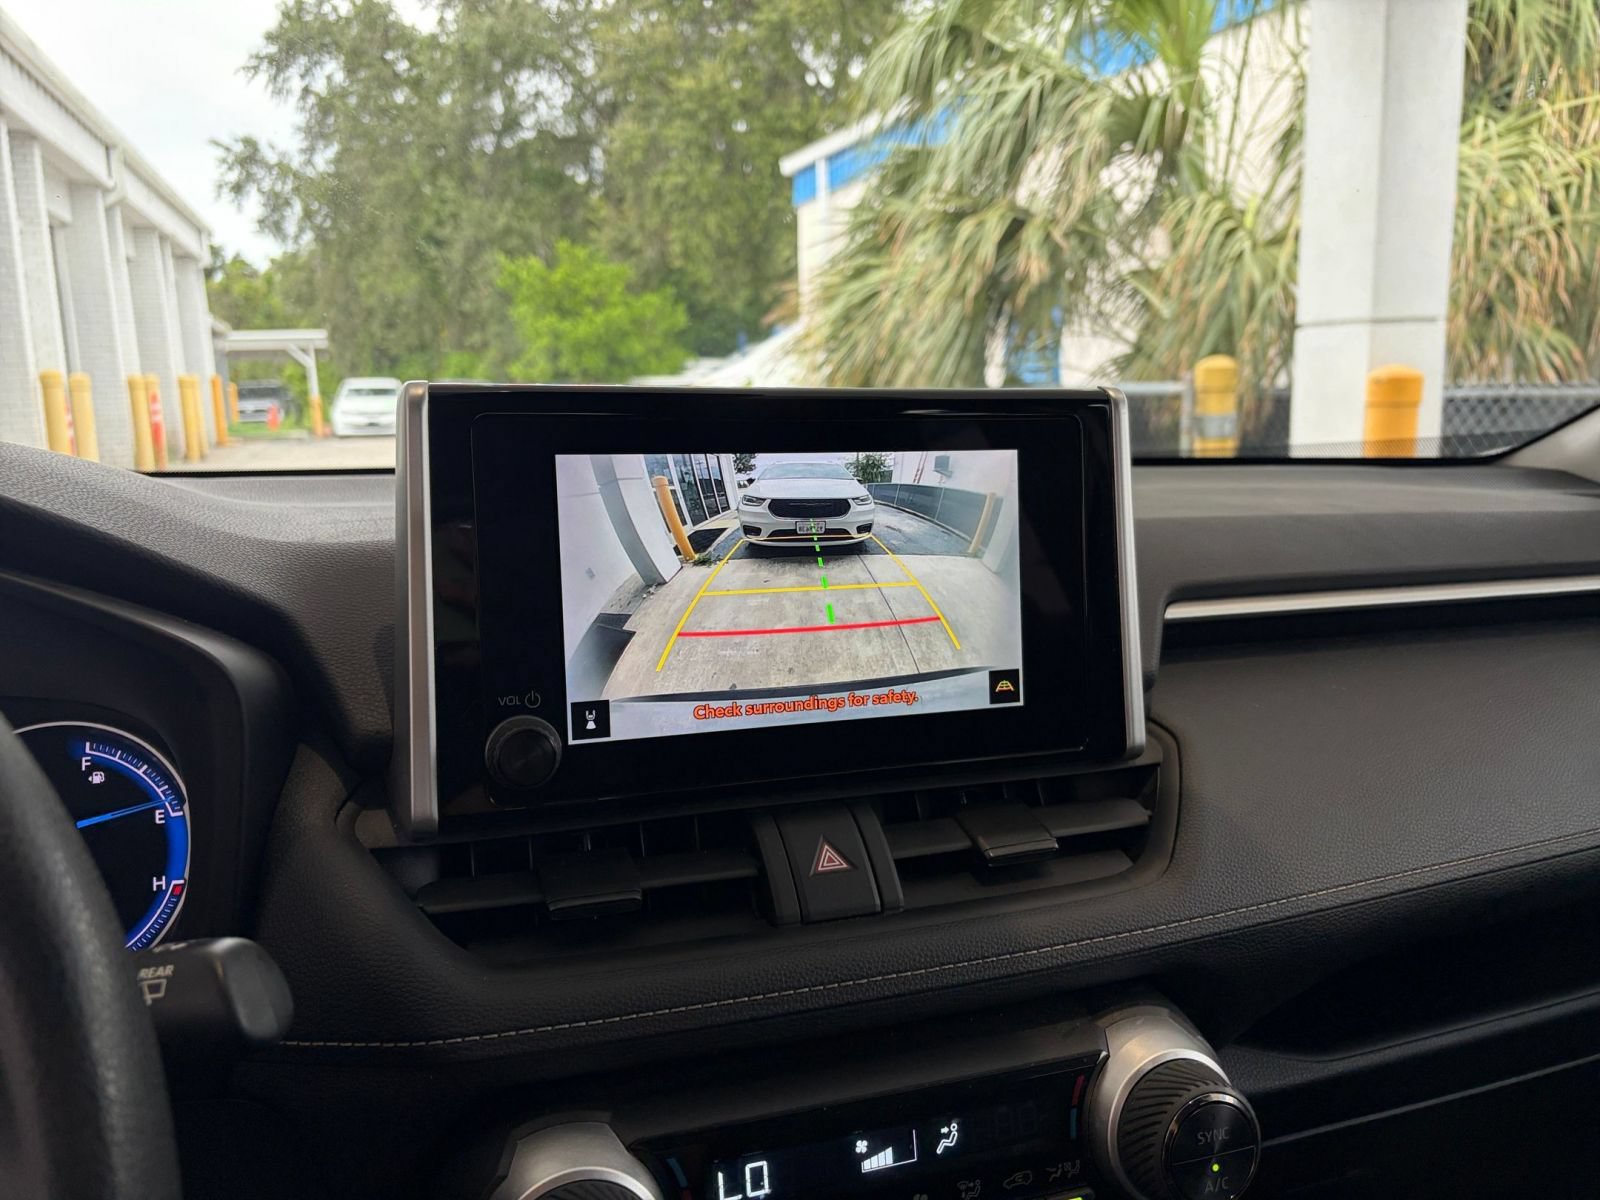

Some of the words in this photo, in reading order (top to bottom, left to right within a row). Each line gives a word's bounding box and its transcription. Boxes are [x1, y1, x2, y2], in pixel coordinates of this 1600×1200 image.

[498, 695, 521, 706] VOL
[693, 702, 742, 720] Check
[745, 694, 845, 716] surroundings
[847, 692, 870, 707] for
[872, 688, 919, 706] safety.
[81, 757, 91, 771] F
[155, 809, 165, 824] E
[152, 875, 166, 891] H
[138, 964, 174, 978] REAR
[1197, 1126, 1230, 1145] SYNC
[1204, 1176, 1230, 1194] A/C
